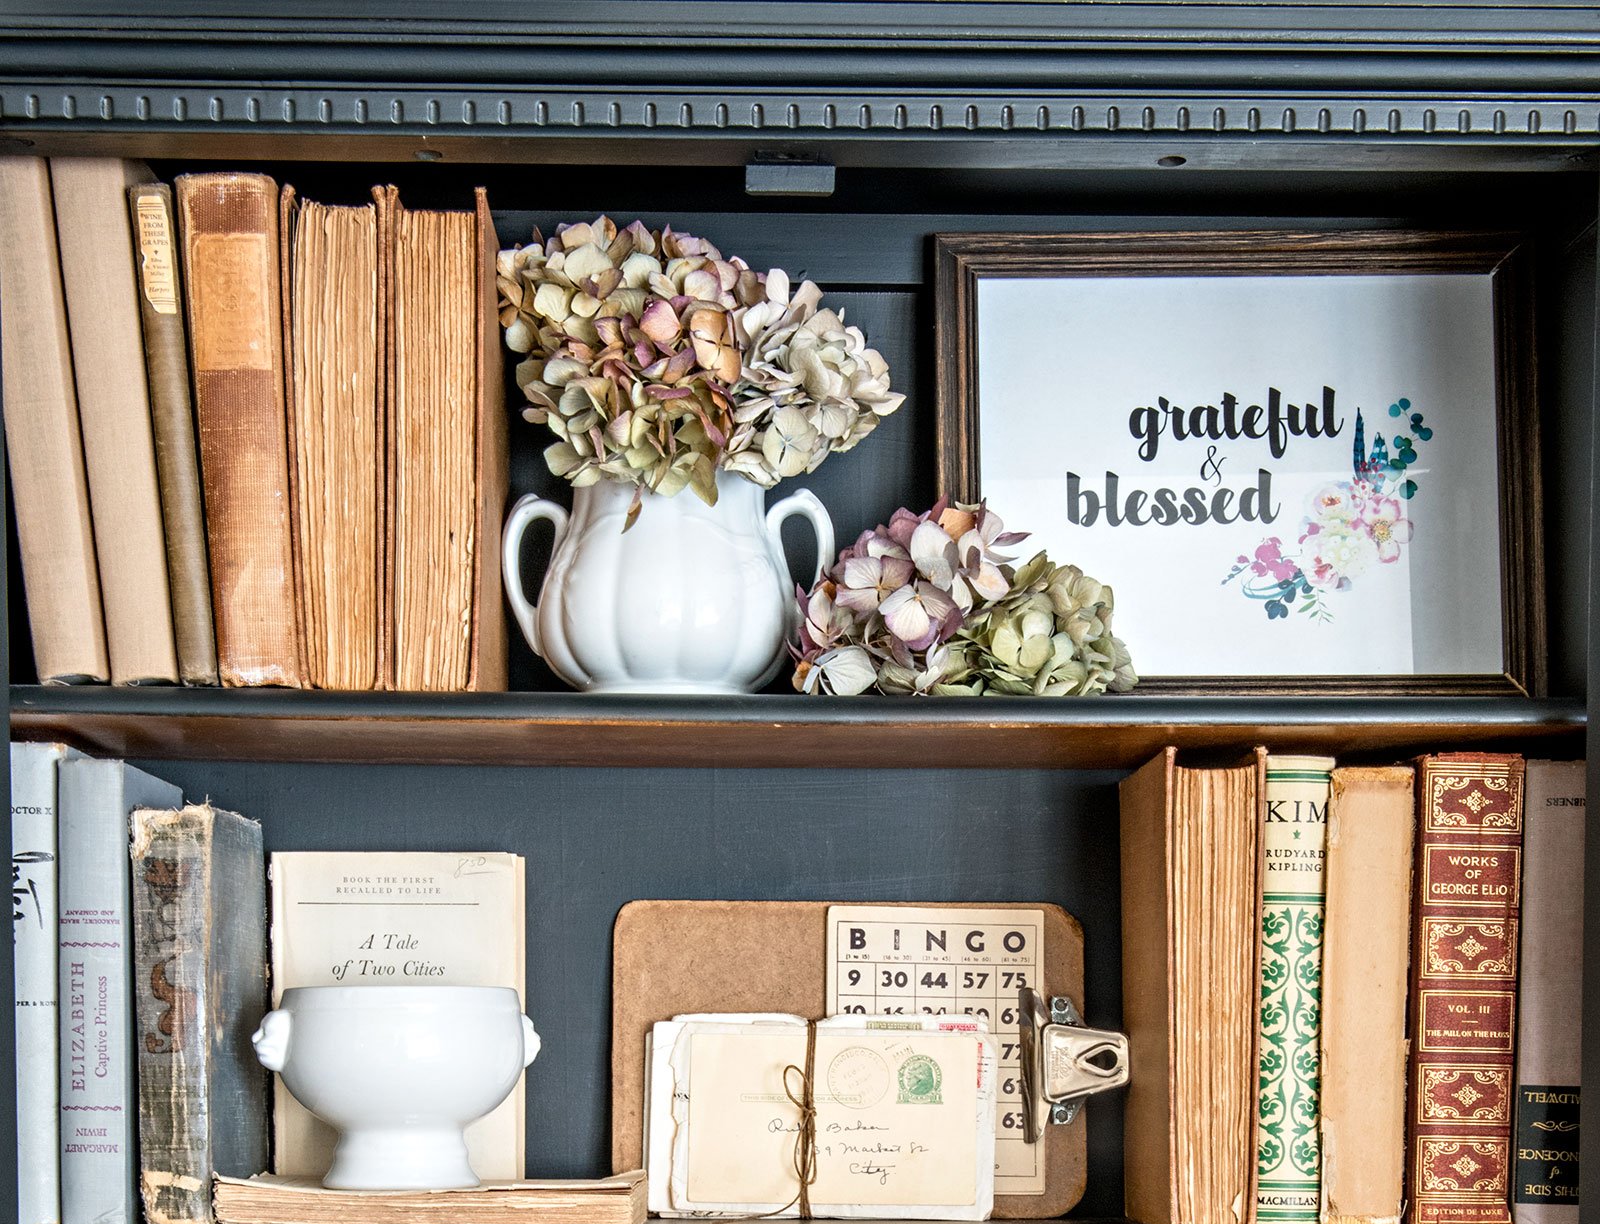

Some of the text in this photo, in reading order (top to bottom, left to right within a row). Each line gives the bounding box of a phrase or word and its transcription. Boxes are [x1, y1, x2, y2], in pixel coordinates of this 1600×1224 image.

[1129, 385, 1344, 461] grateful
[1200, 445, 1227, 487] &
[1066, 468, 1281, 527] blessed
[45, 807, 53, 815] X
[1265, 800, 1328, 823] KIM
[1266, 849, 1326, 859] RUDYARD
[1268, 862, 1322, 872] KIPLING
[1448, 855, 1499, 867] WORKS
[343, 876, 372, 884] BOOK
[377, 876, 399, 884] THE
[1464, 869, 1483, 879] OF
[336, 886, 393, 894] RECALLED
[1431, 882, 1479, 895] GEORGE
[359, 933, 420, 950] A Tale
[331, 960, 446, 981] of Two Cities
[848, 969, 1027, 989] 9 30 44 57 75
[1448, 1005, 1490, 1014] VOL. III
[71, 961, 86, 1092] ELIZABETH
[94, 975, 110, 1078] Captive Princess
[1426, 1029, 1441, 1037] THE
[1461, 1030, 1472, 1038] ON
[1473, 1030, 1489, 1038] THE
[76, 1128, 107, 1137] IRWIN
[65, 1144, 119, 1154] MARGARET
[1549, 1166, 1560, 1179] of
[1526, 1184, 1551, 1197] SIDE
[1257, 1196, 1318, 1206] MACMILLAN
